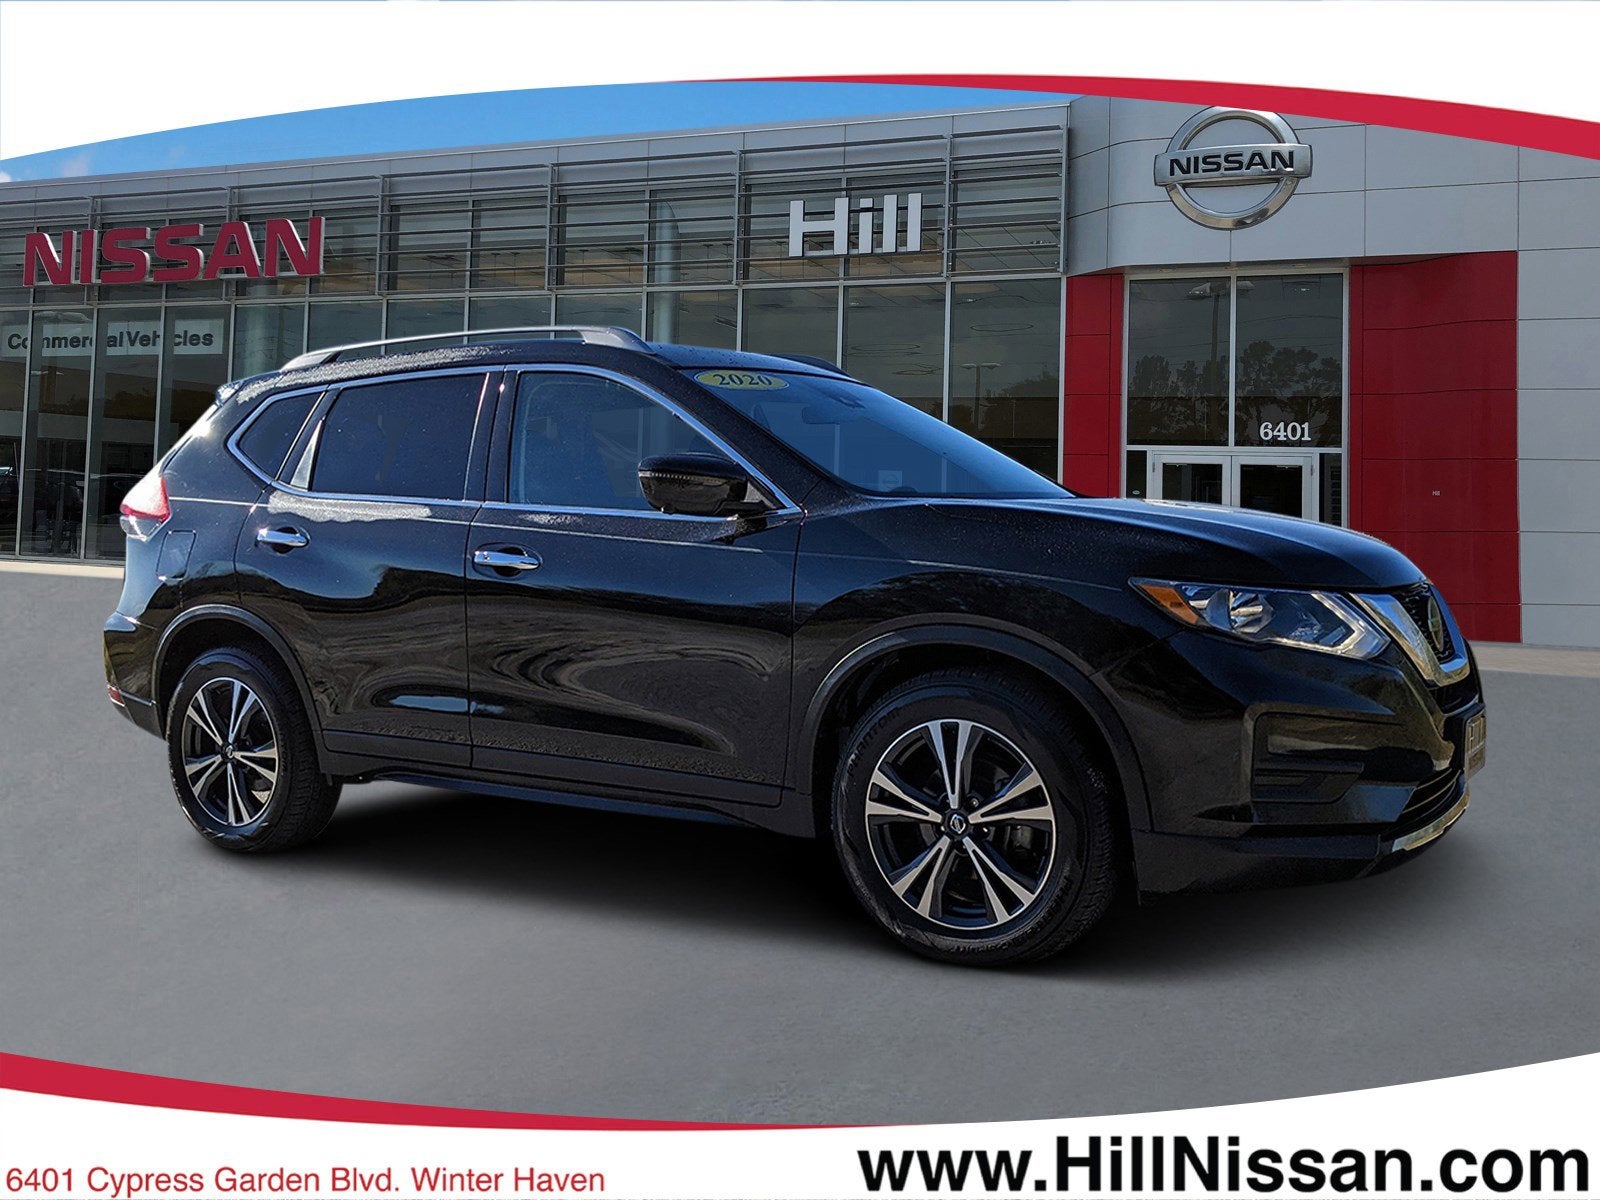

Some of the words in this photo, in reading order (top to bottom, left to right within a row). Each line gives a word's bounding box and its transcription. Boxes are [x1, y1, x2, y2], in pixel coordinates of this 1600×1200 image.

[1169, 150, 1294, 177] NISSAN
[788, 192, 922, 257] Hill
[23, 216, 325, 287] NISSAN
[7, 329, 124, 350] Cmeral
[126, 330, 214, 347] Vehcles
[712, 373, 773, 386] 2020
[1259, 421, 1312, 441] 6401
